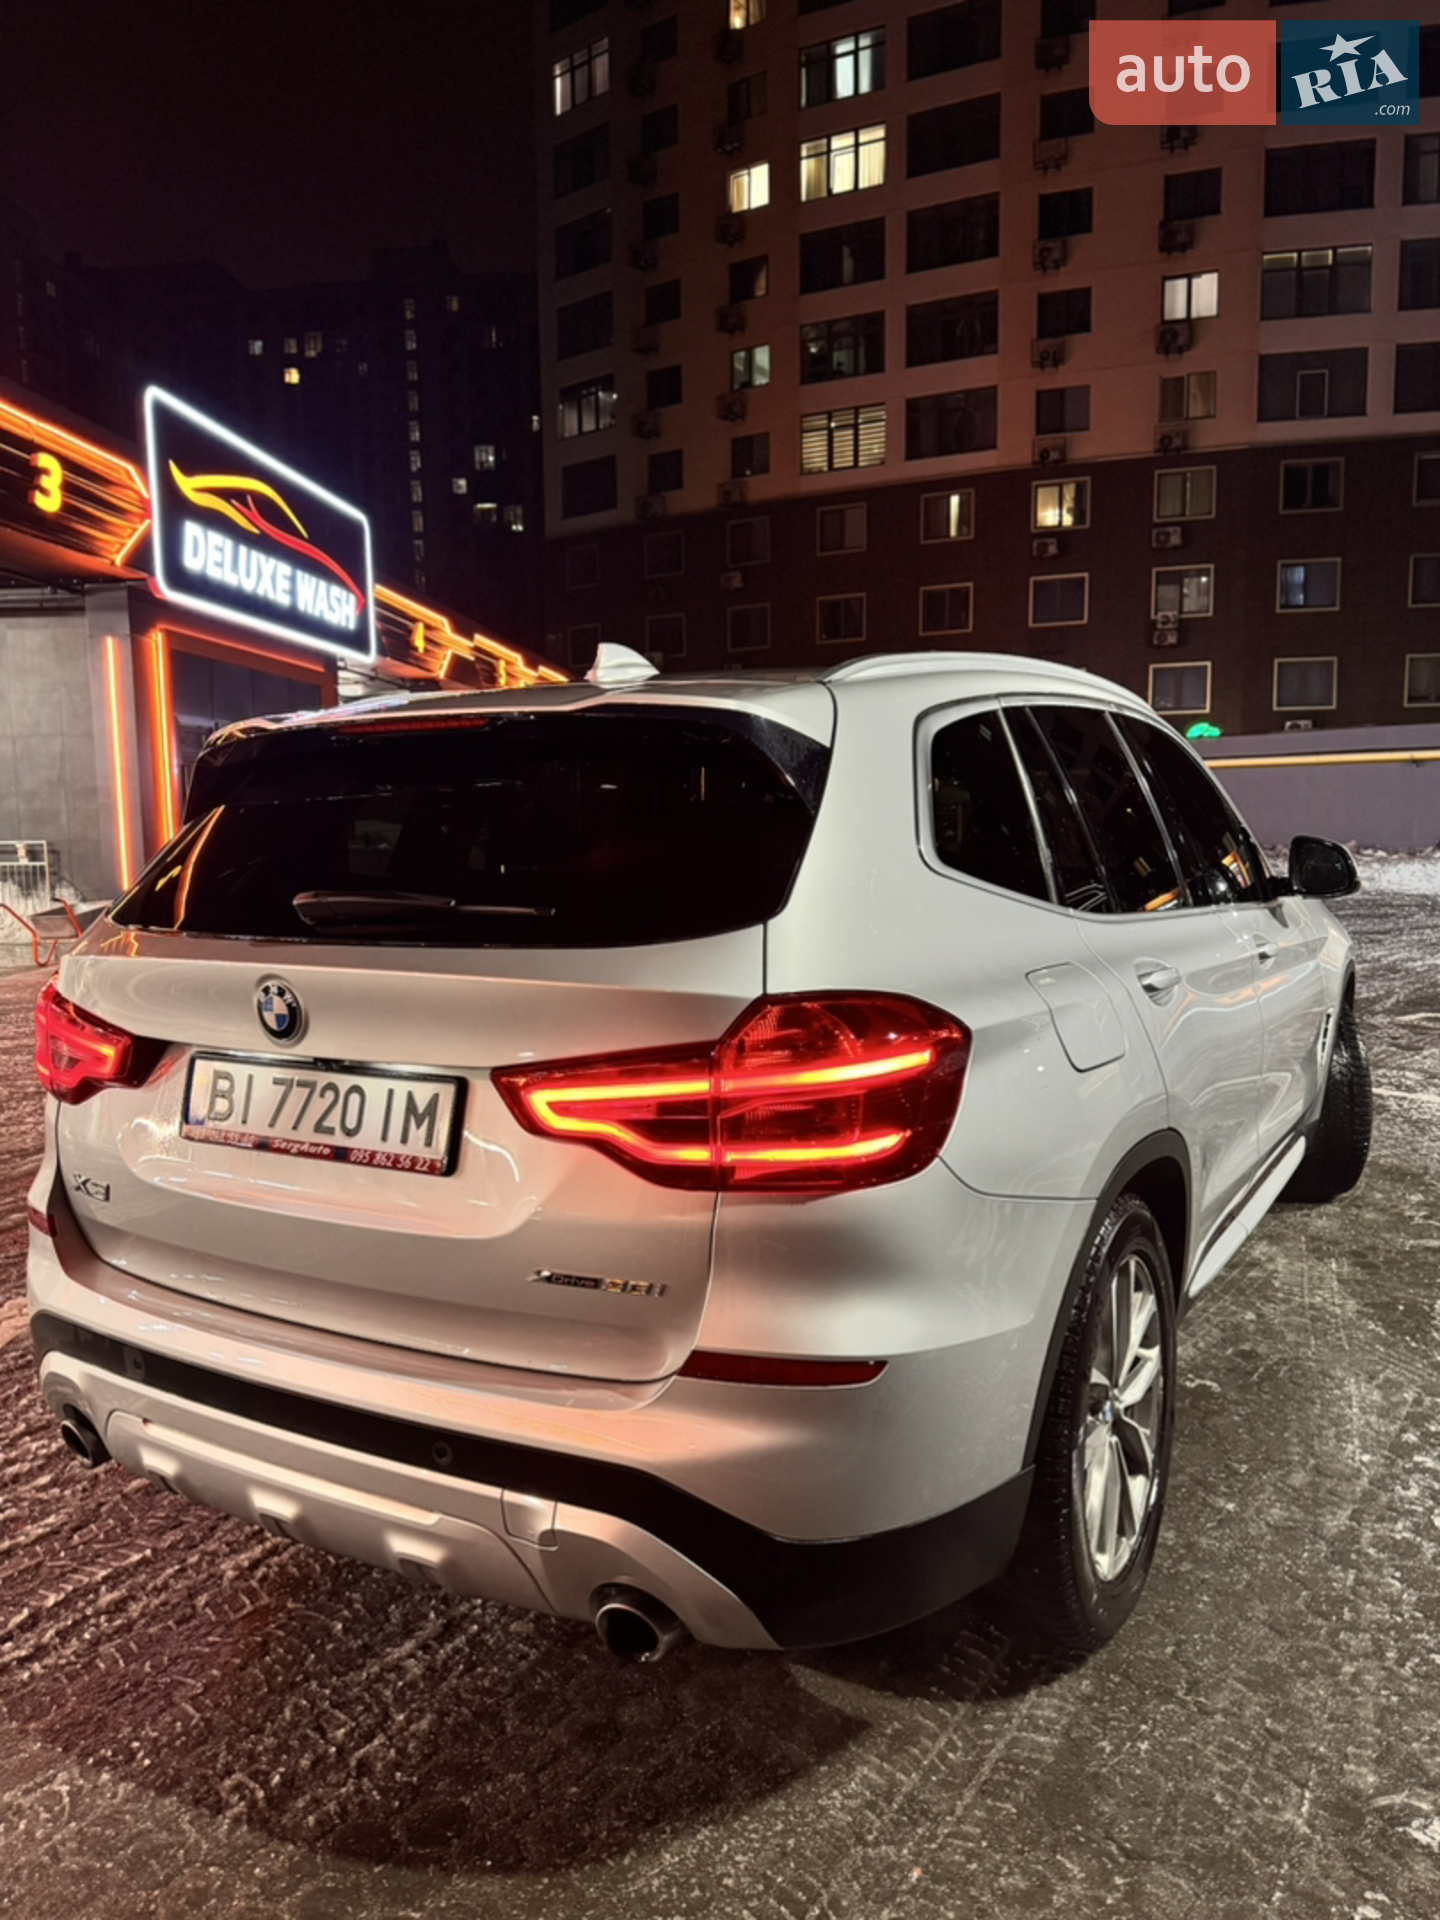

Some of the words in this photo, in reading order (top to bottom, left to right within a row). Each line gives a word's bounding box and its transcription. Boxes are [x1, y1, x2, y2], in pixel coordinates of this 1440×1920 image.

[31, 452, 62, 513] 3
[183, 519, 293, 608] DELUXE
[295, 567, 358, 632] WASH
[413, 622, 425, 653] 4
[207, 1068, 254, 1125] BI
[267, 1075, 367, 1138] 7720
[380, 1087, 441, 1148] IM
[272, 1139, 331, 1156] SergAuto
[73, 1173, 111, 1202] X3
